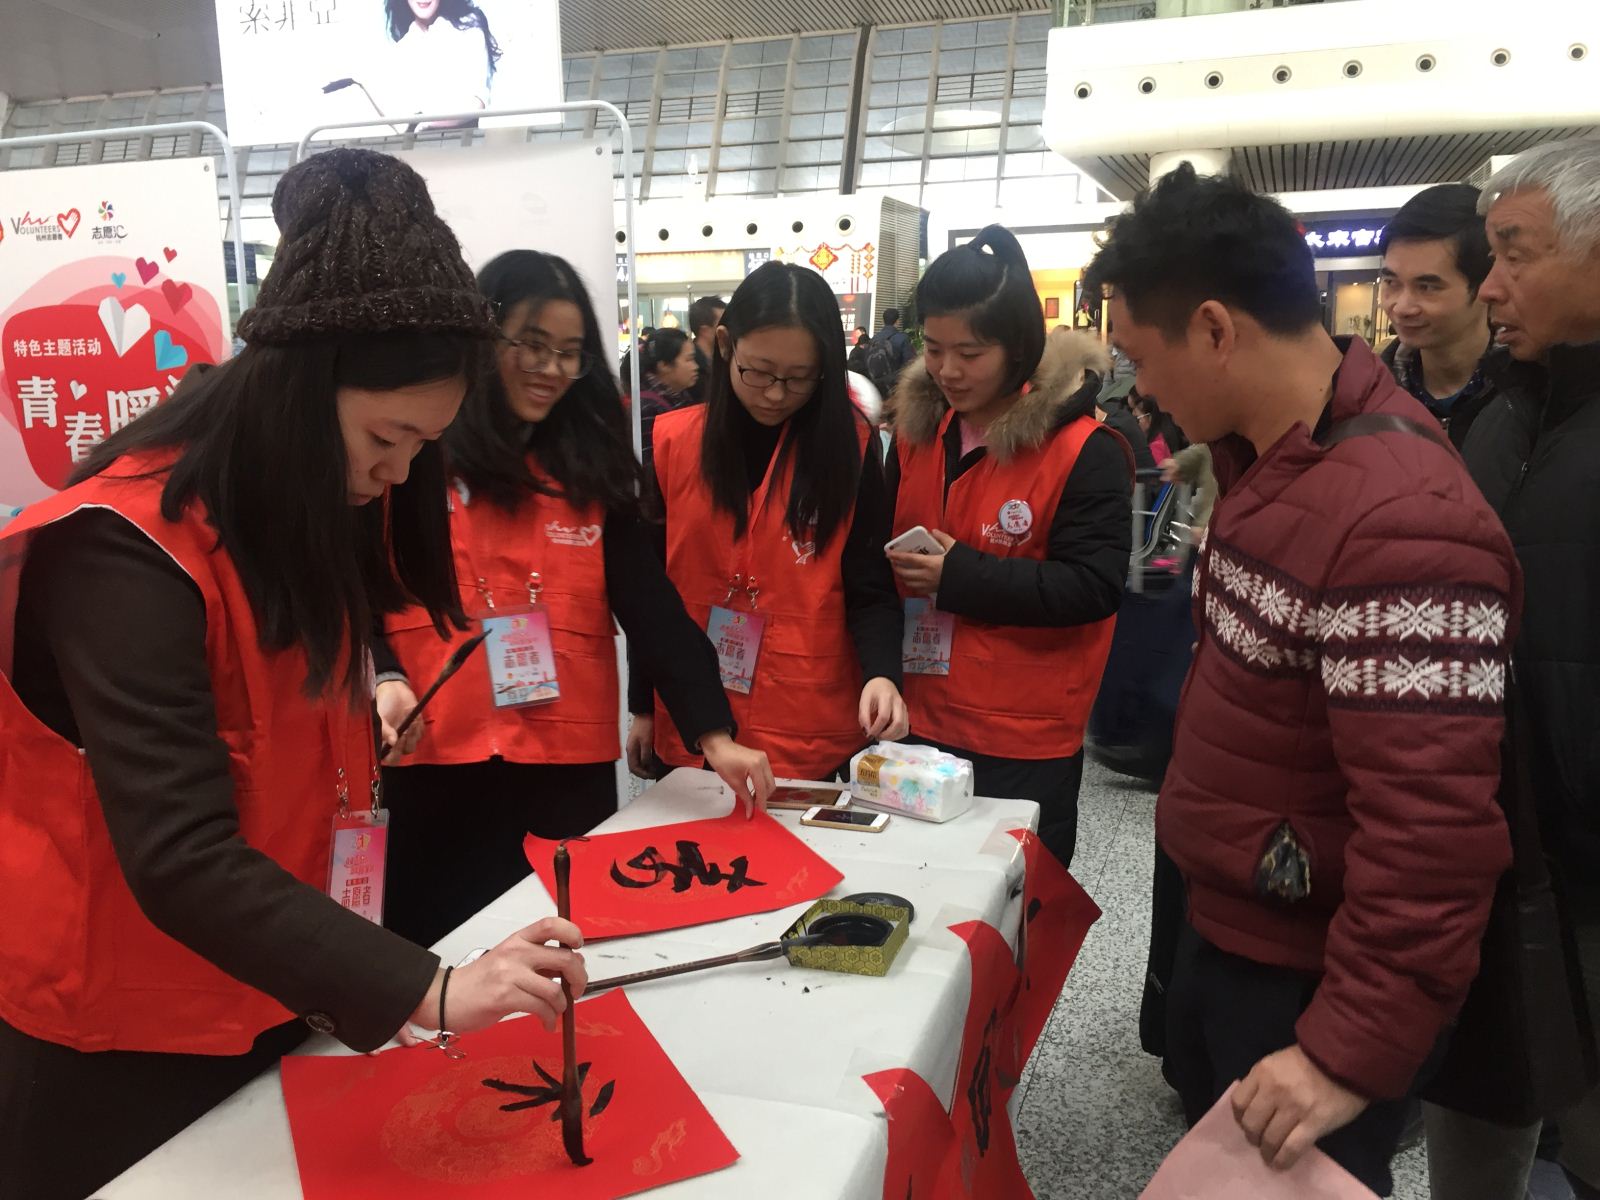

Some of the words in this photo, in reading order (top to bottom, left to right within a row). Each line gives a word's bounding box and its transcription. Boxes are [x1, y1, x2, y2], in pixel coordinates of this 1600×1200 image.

[91, 225, 128, 240] 志愿汇
[13, 339, 102, 357] 特色主题活动
